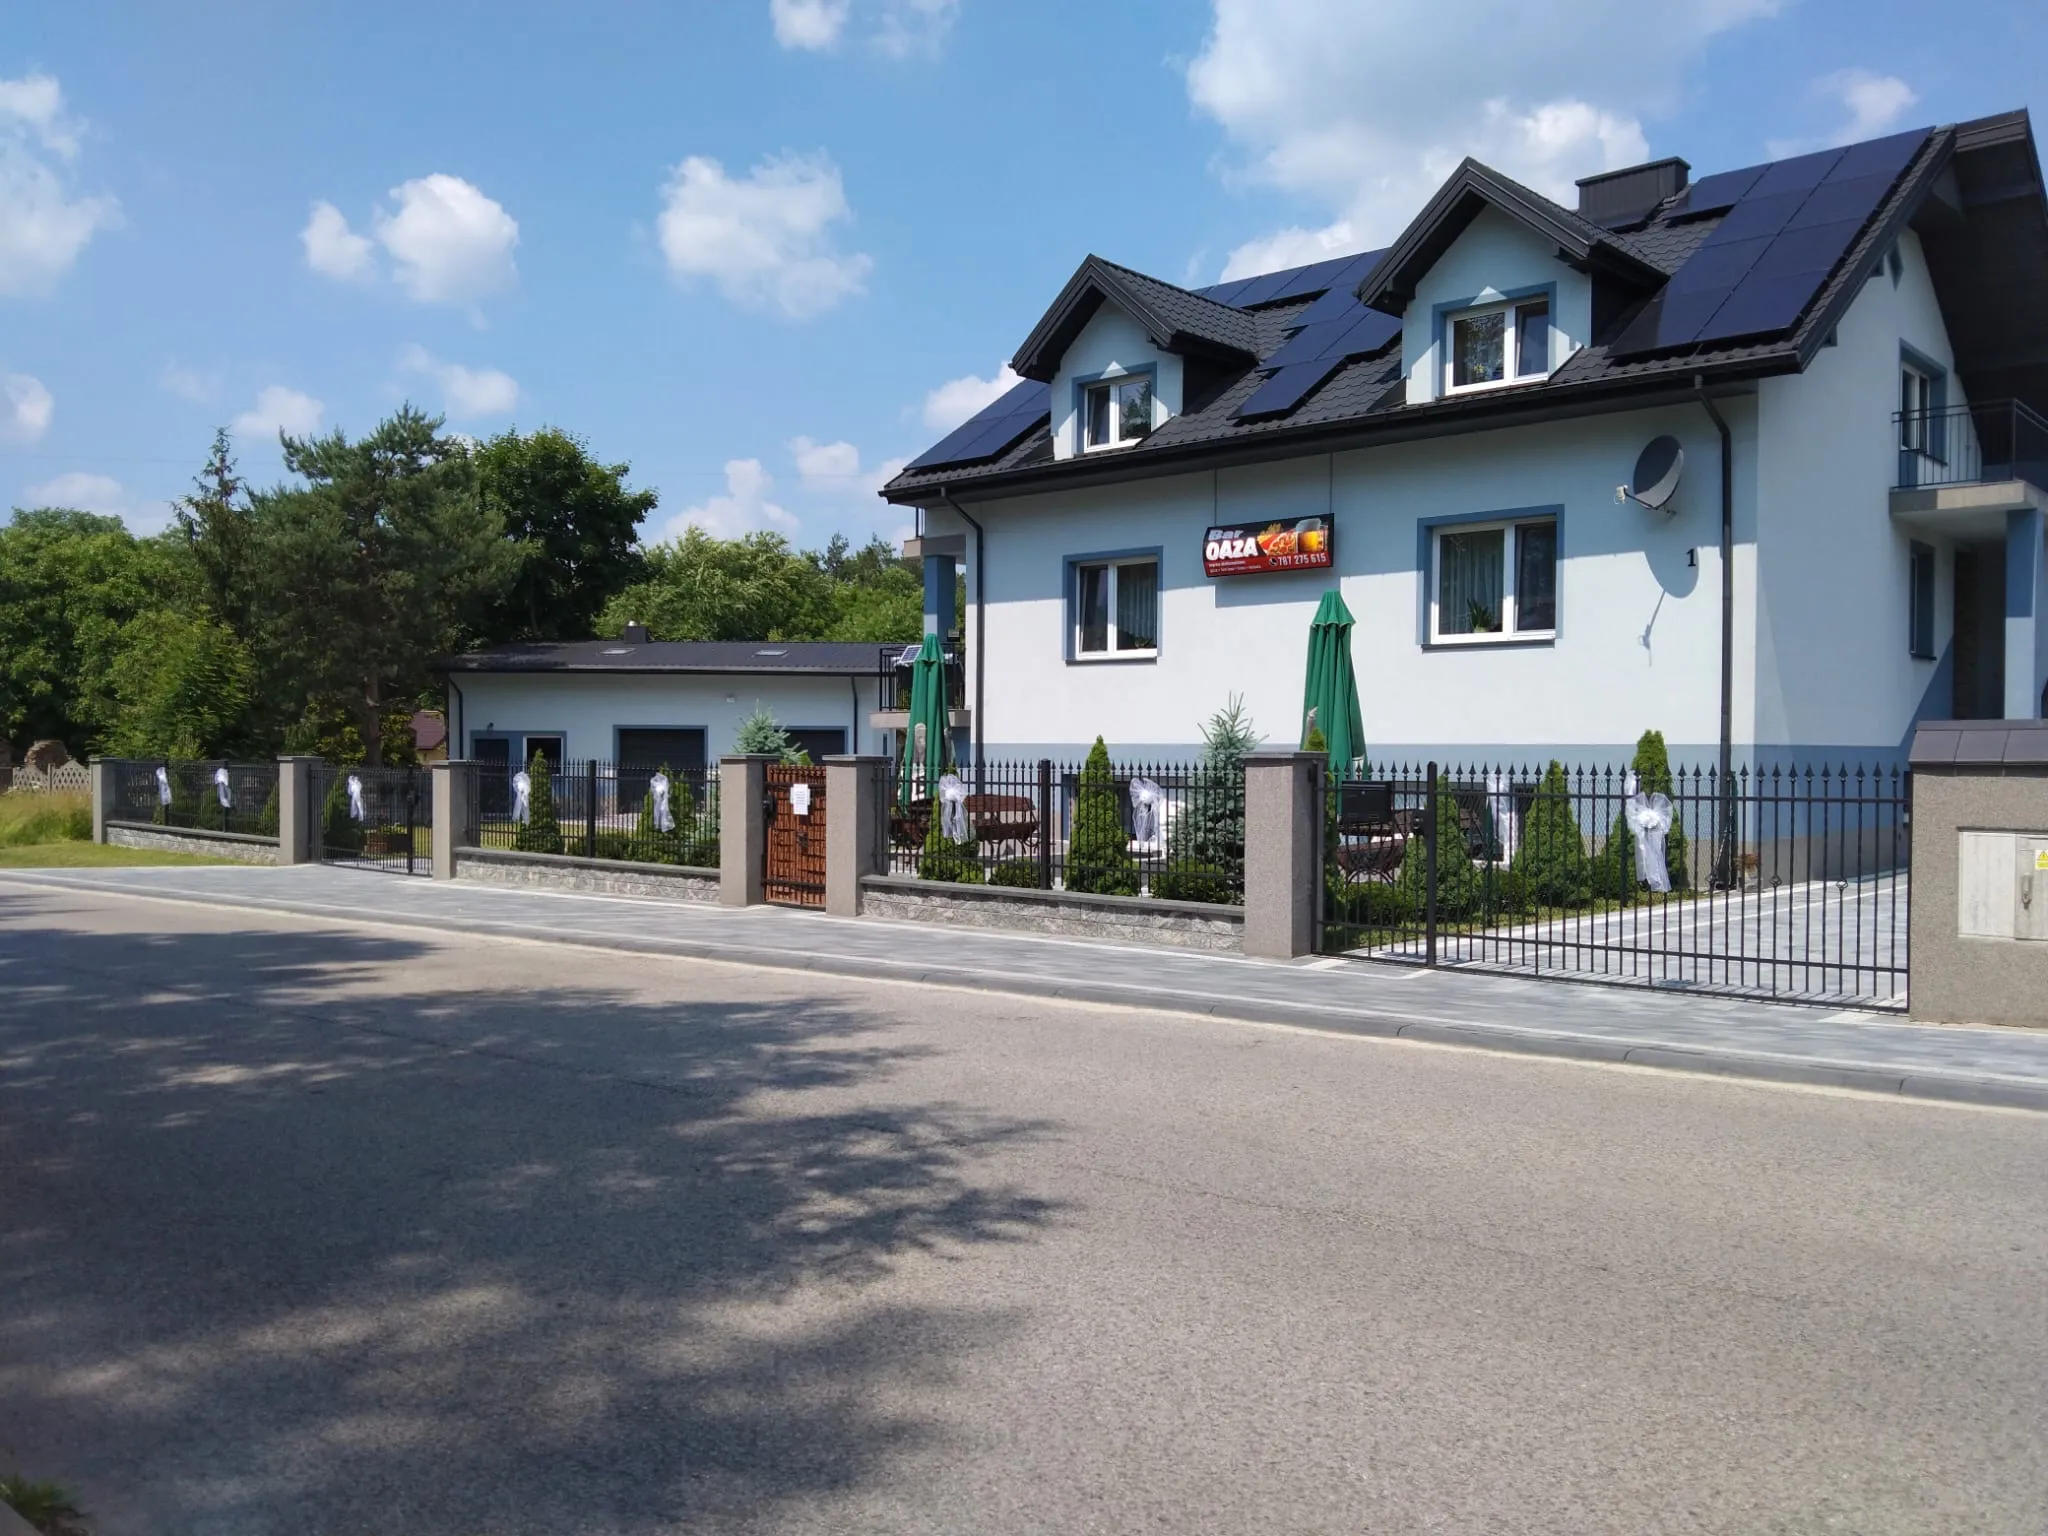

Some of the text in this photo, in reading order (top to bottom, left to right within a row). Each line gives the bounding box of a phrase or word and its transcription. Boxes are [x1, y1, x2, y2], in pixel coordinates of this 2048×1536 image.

[1208, 529, 1244, 541] Bar
[1206, 537, 1259, 560] OAZA
[1294, 554, 1309, 565] 275
[1310, 552, 1327, 563] 615
[1685, 548, 1697, 567] 1
